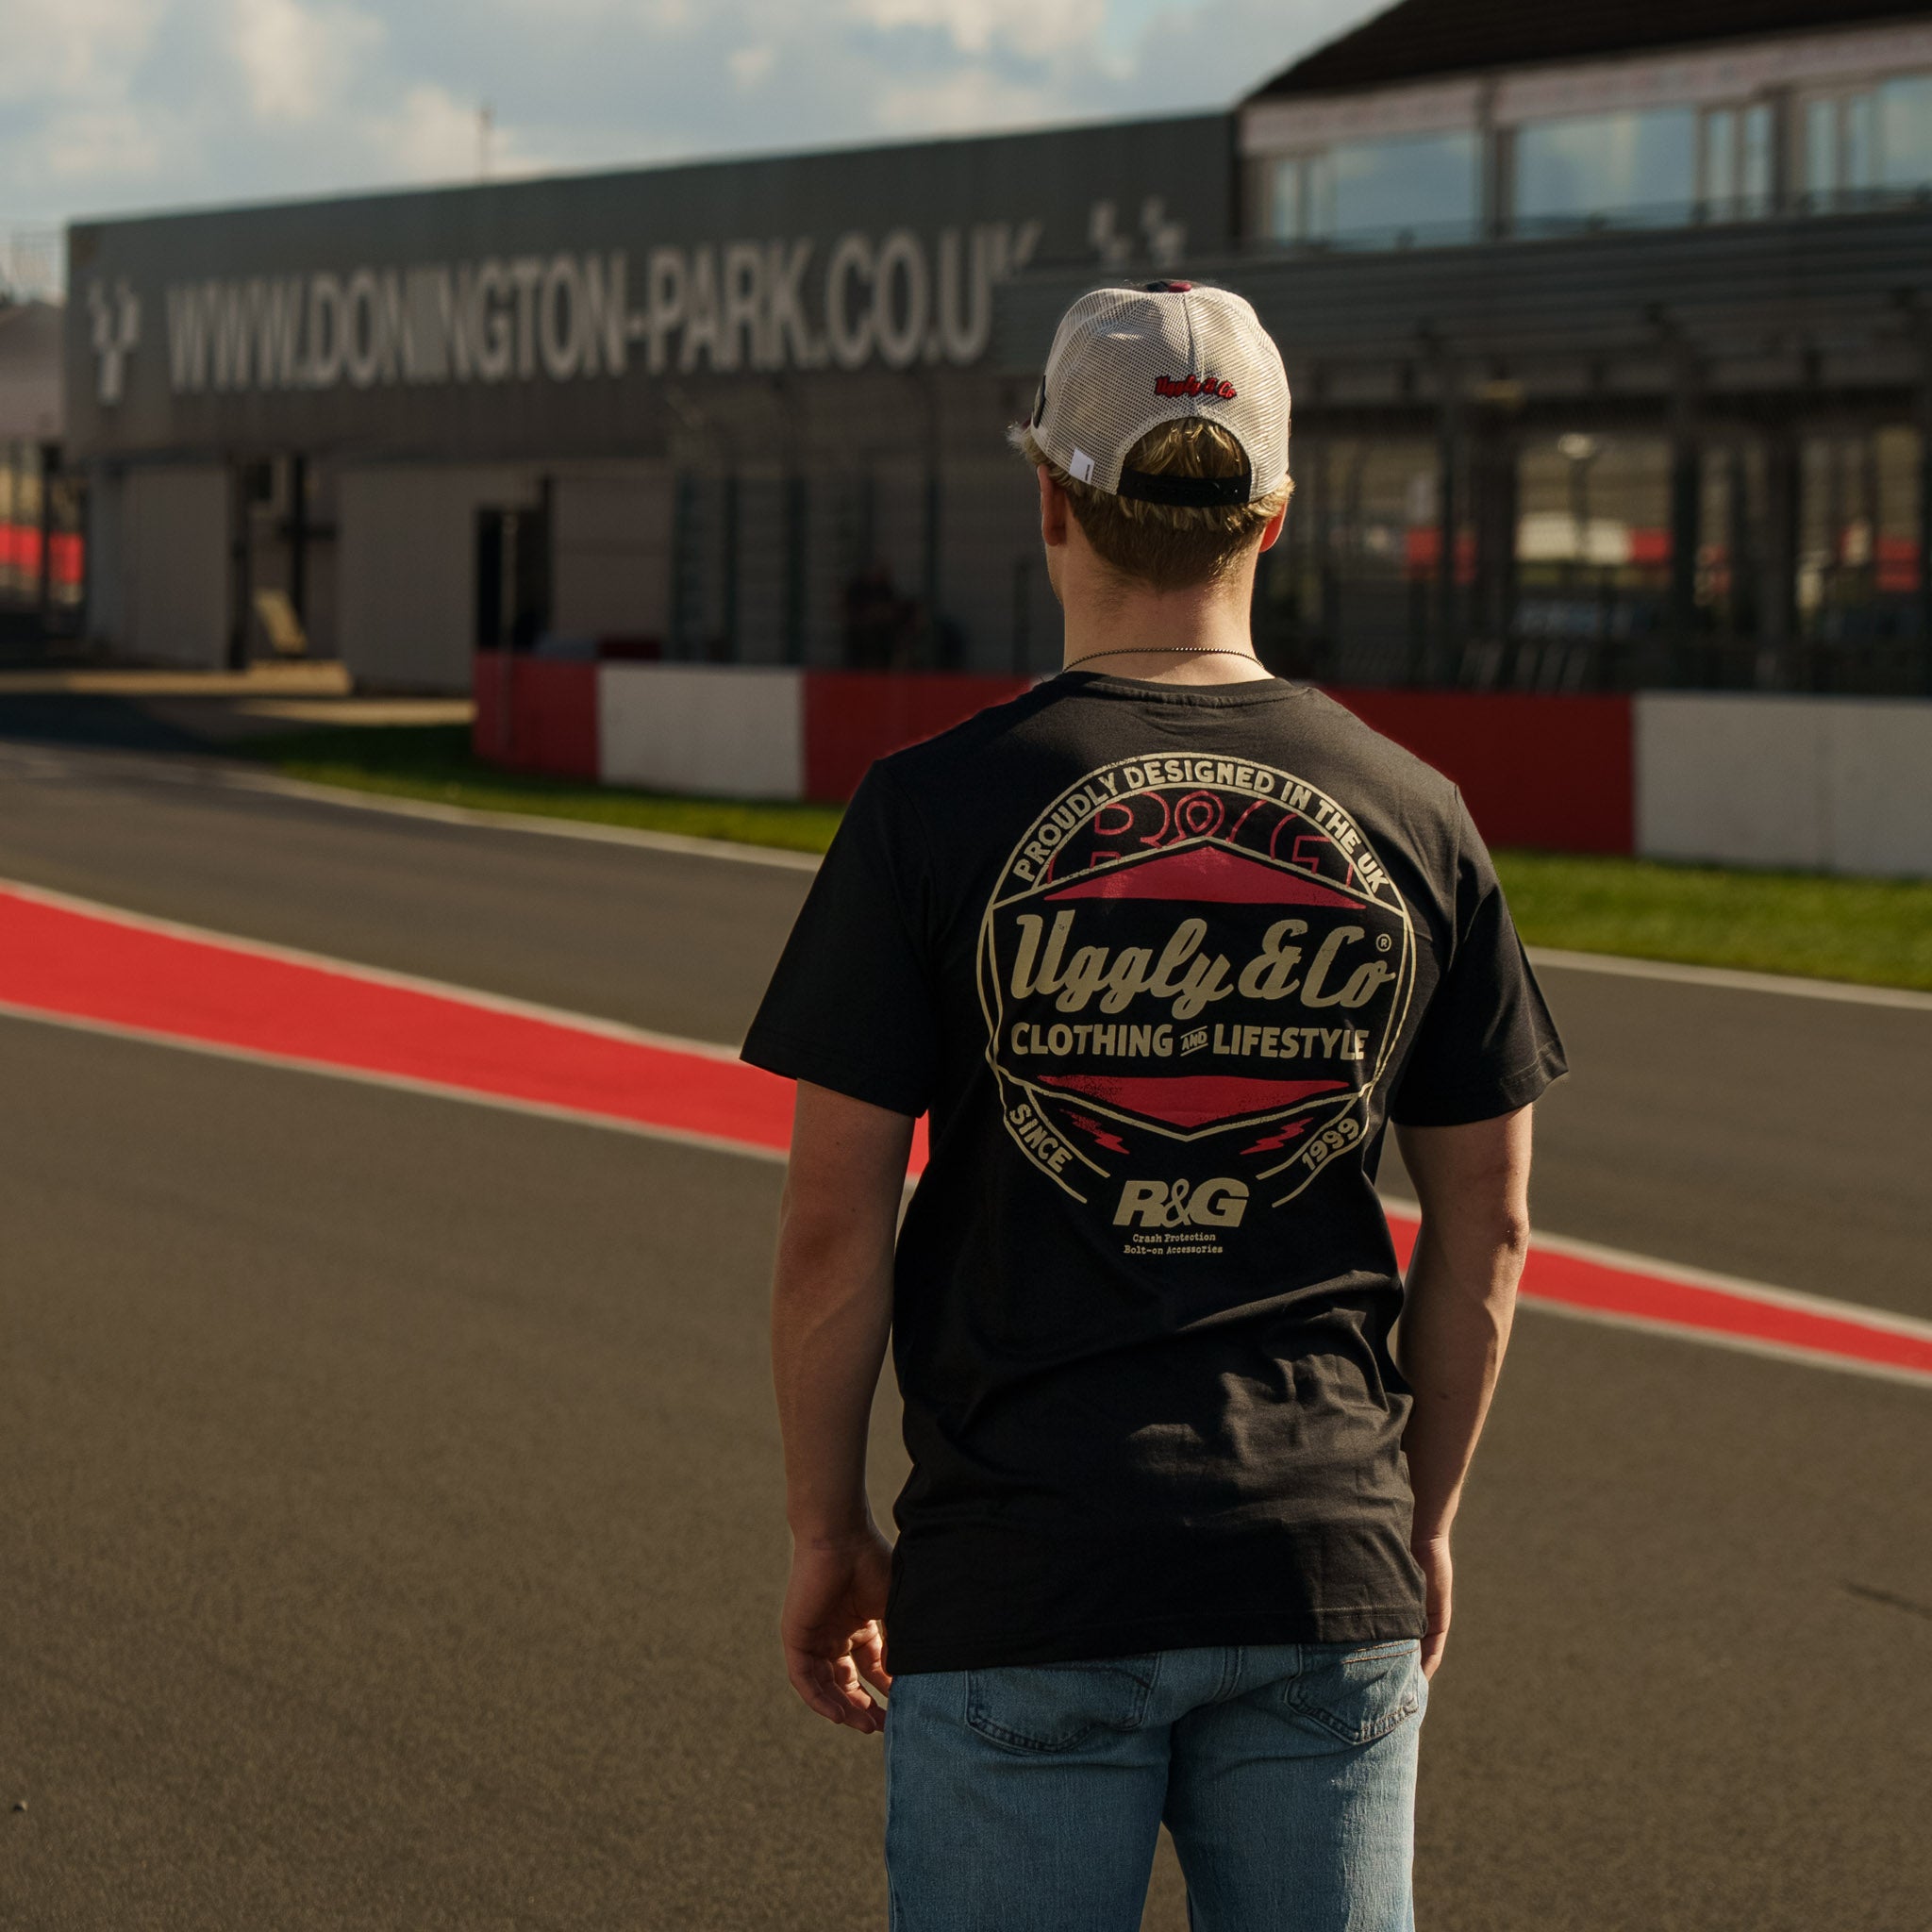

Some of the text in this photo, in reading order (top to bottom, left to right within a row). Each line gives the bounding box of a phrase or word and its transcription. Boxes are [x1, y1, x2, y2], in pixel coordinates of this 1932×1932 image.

[1012, 758, 1390, 885] PROUDLY DESIGNED IN THE UK
[1010, 1023, 1370, 1060] CLOTHING AND LIFESTYLE
[1009, 1103, 1073, 1174] SINCE
[1302, 1118, 1359, 1171] 1999
[1112, 1177, 1250, 1227] R&G
[1124, 1244, 1224, 1255] Bolt-on Accessories
[1132, 1232, 1216, 1243] Crash Protection
